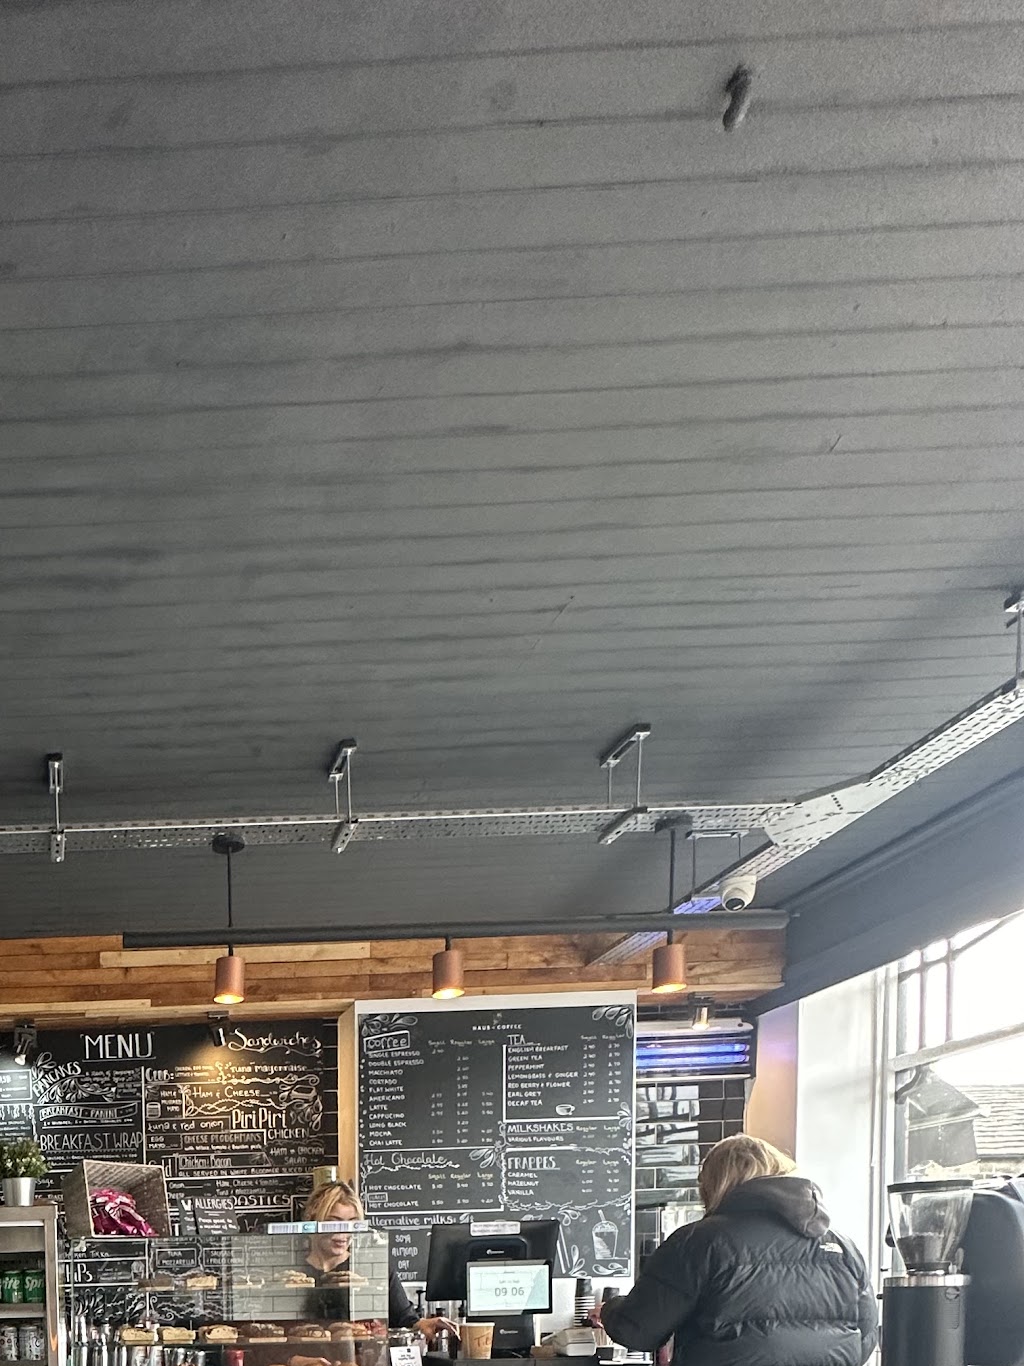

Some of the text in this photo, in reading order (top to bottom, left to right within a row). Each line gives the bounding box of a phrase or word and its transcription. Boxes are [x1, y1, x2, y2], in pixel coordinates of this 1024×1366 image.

[507, 1034, 525, 1045] TEA
[84, 1033, 152, 1059] MENU
[33, 1061, 81, 1097] PANCAKES
[231, 1108, 286, 1129] Piri Piri
[268, 1128, 309, 1140] CHICKEN
[507, 1123, 573, 1133] MILKSHAKES
[40, 1132, 143, 1151] BREAKFAST WRAP
[364, 1152, 447, 1165] Hot Chocolate
[507, 1156, 556, 1169] FRAPPES
[195, 1199, 234, 1211] ALLERGIES
[395, 1234, 411, 1243] SOYA
[391, 1247, 418, 1257] ALMOND
[398, 1260, 409, 1270] OAT
